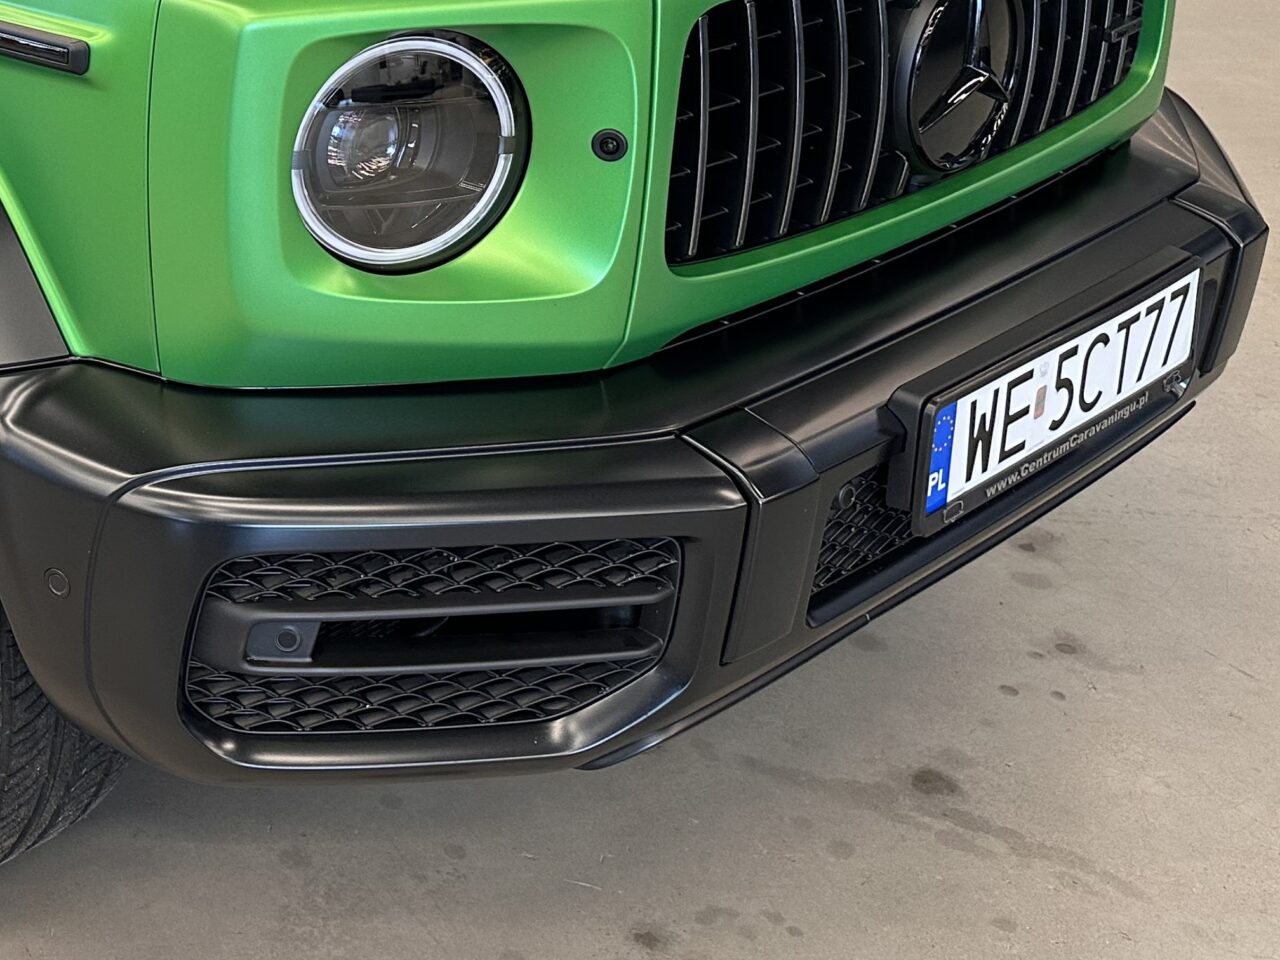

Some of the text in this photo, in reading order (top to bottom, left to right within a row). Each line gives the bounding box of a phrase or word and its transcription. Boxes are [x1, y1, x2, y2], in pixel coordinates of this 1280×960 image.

[965, 282, 1190, 483] WE 5CT77
[927, 469, 946, 496] PL
[985, 391, 1149, 498] www.CentrumCaravaningu.pl
